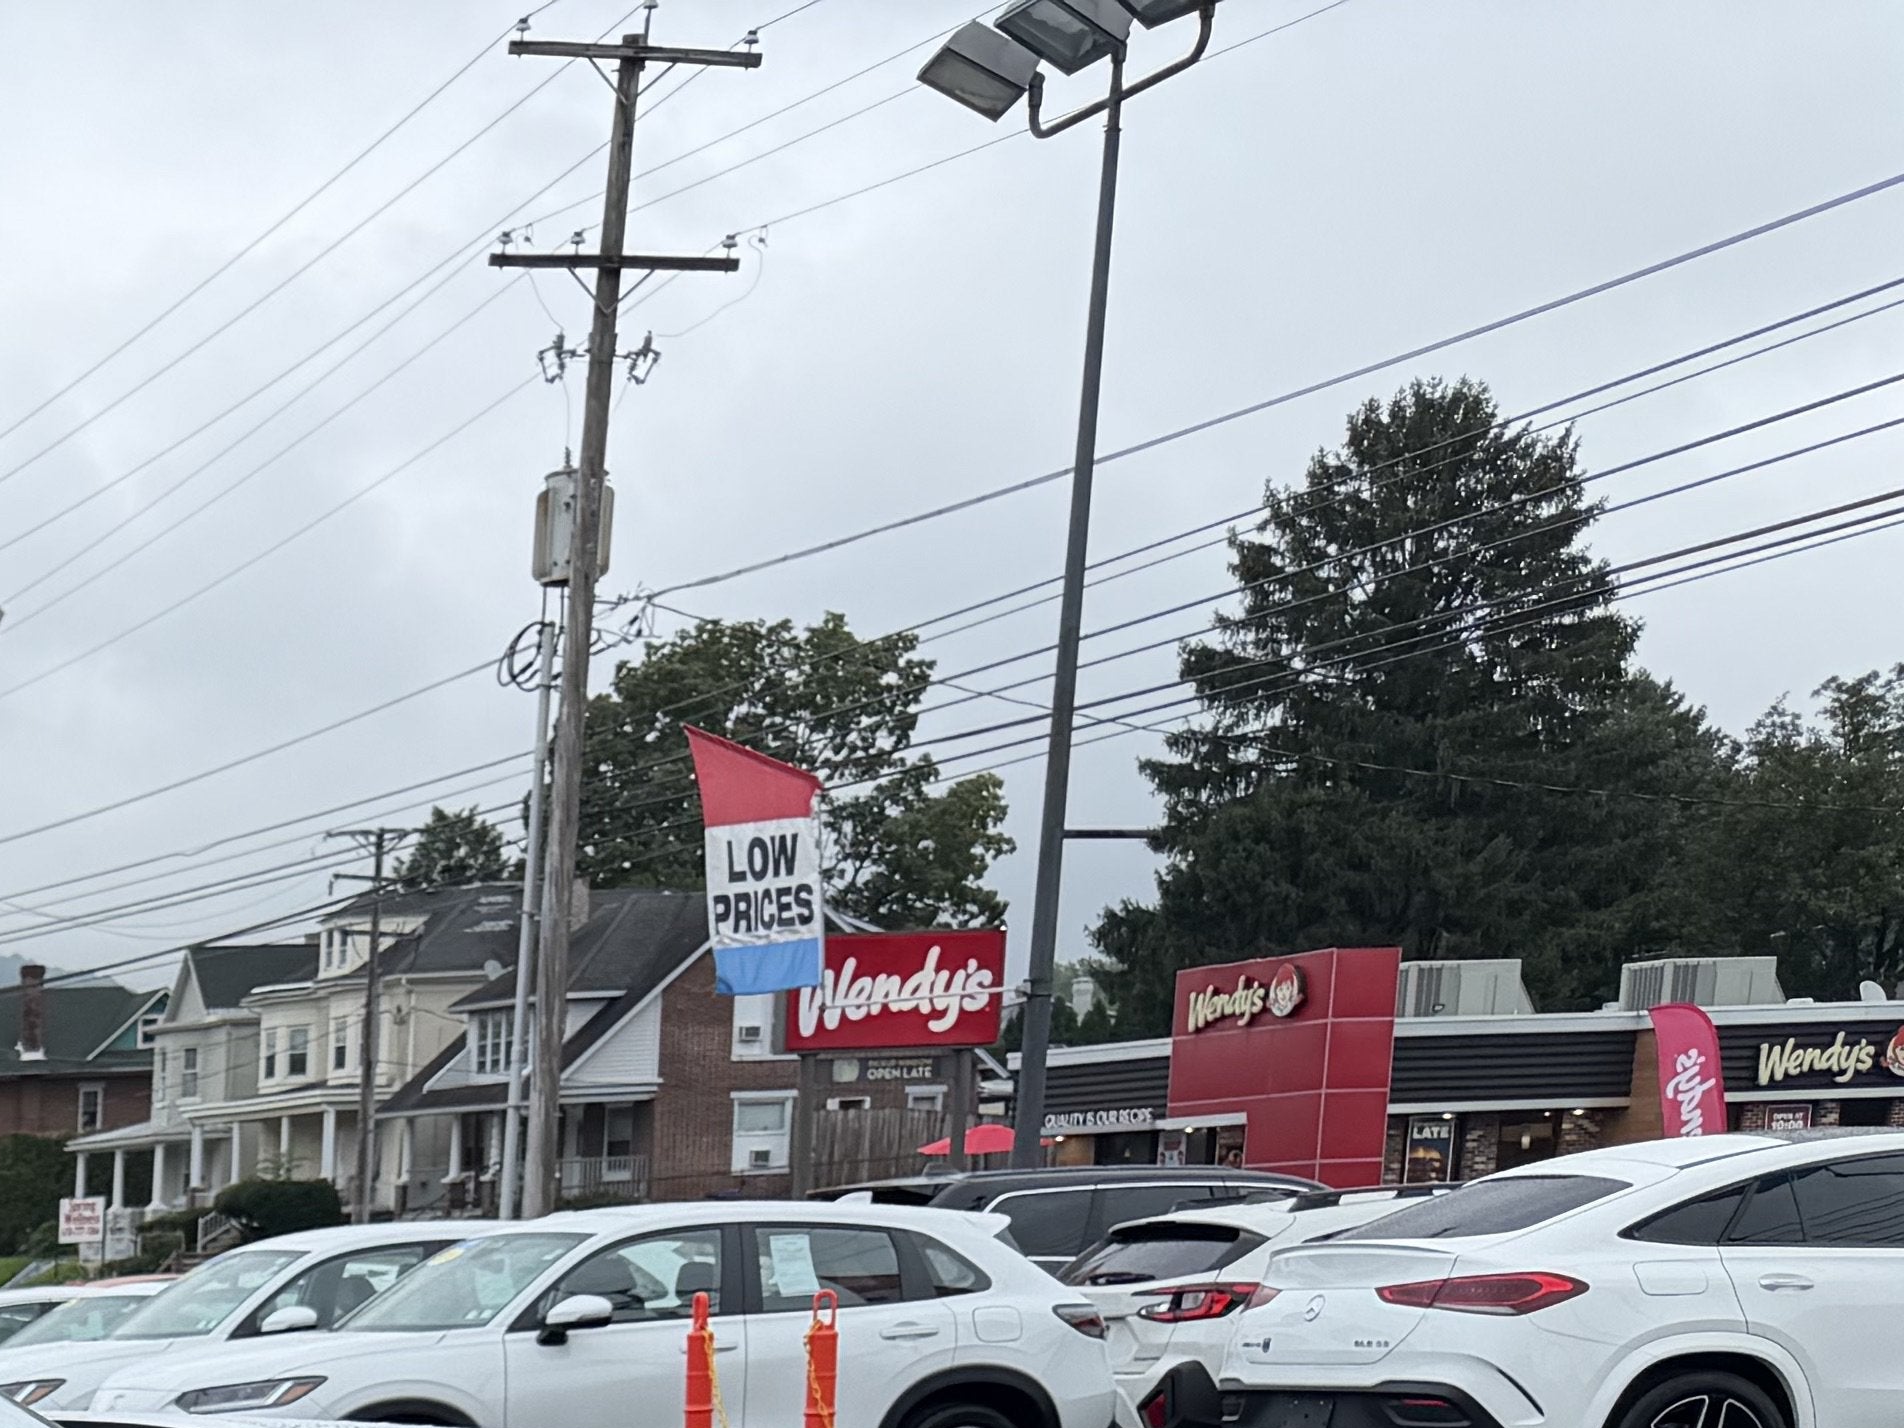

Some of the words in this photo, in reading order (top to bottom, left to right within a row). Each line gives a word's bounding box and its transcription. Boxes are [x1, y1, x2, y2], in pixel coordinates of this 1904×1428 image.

[727, 832, 799, 883] LOW
[713, 883, 815, 934] PRICES
[798, 945, 993, 1037] Wendy's
[1188, 974, 1265, 1032] Wendy's
[867, 1067, 901, 1080] OPEN
[903, 1066, 932, 1078] LATE
[1758, 1030, 1876, 1086] Wendy's
[1413, 1126, 1449, 1139] LATE
